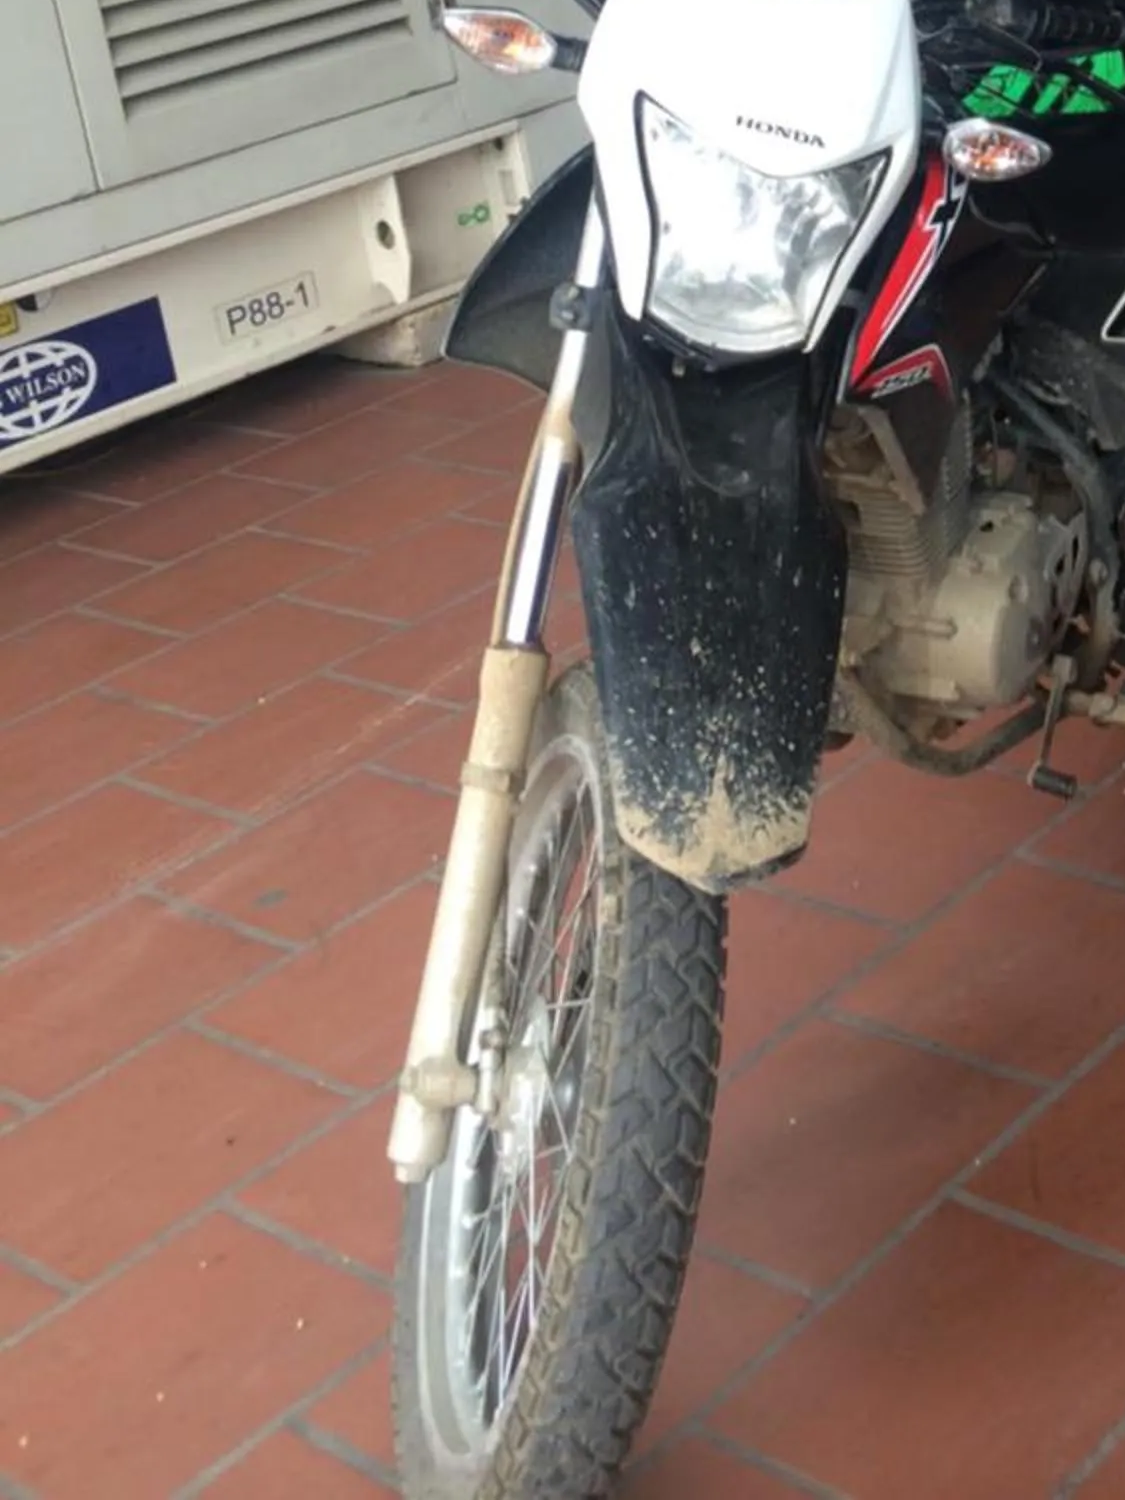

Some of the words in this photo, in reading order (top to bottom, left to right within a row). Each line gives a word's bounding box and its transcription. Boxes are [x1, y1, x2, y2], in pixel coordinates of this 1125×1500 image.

[735, 114, 827, 149] HONDA
[226, 280, 312, 336] P88-1
[5, 363, 86, 404] WILSON
